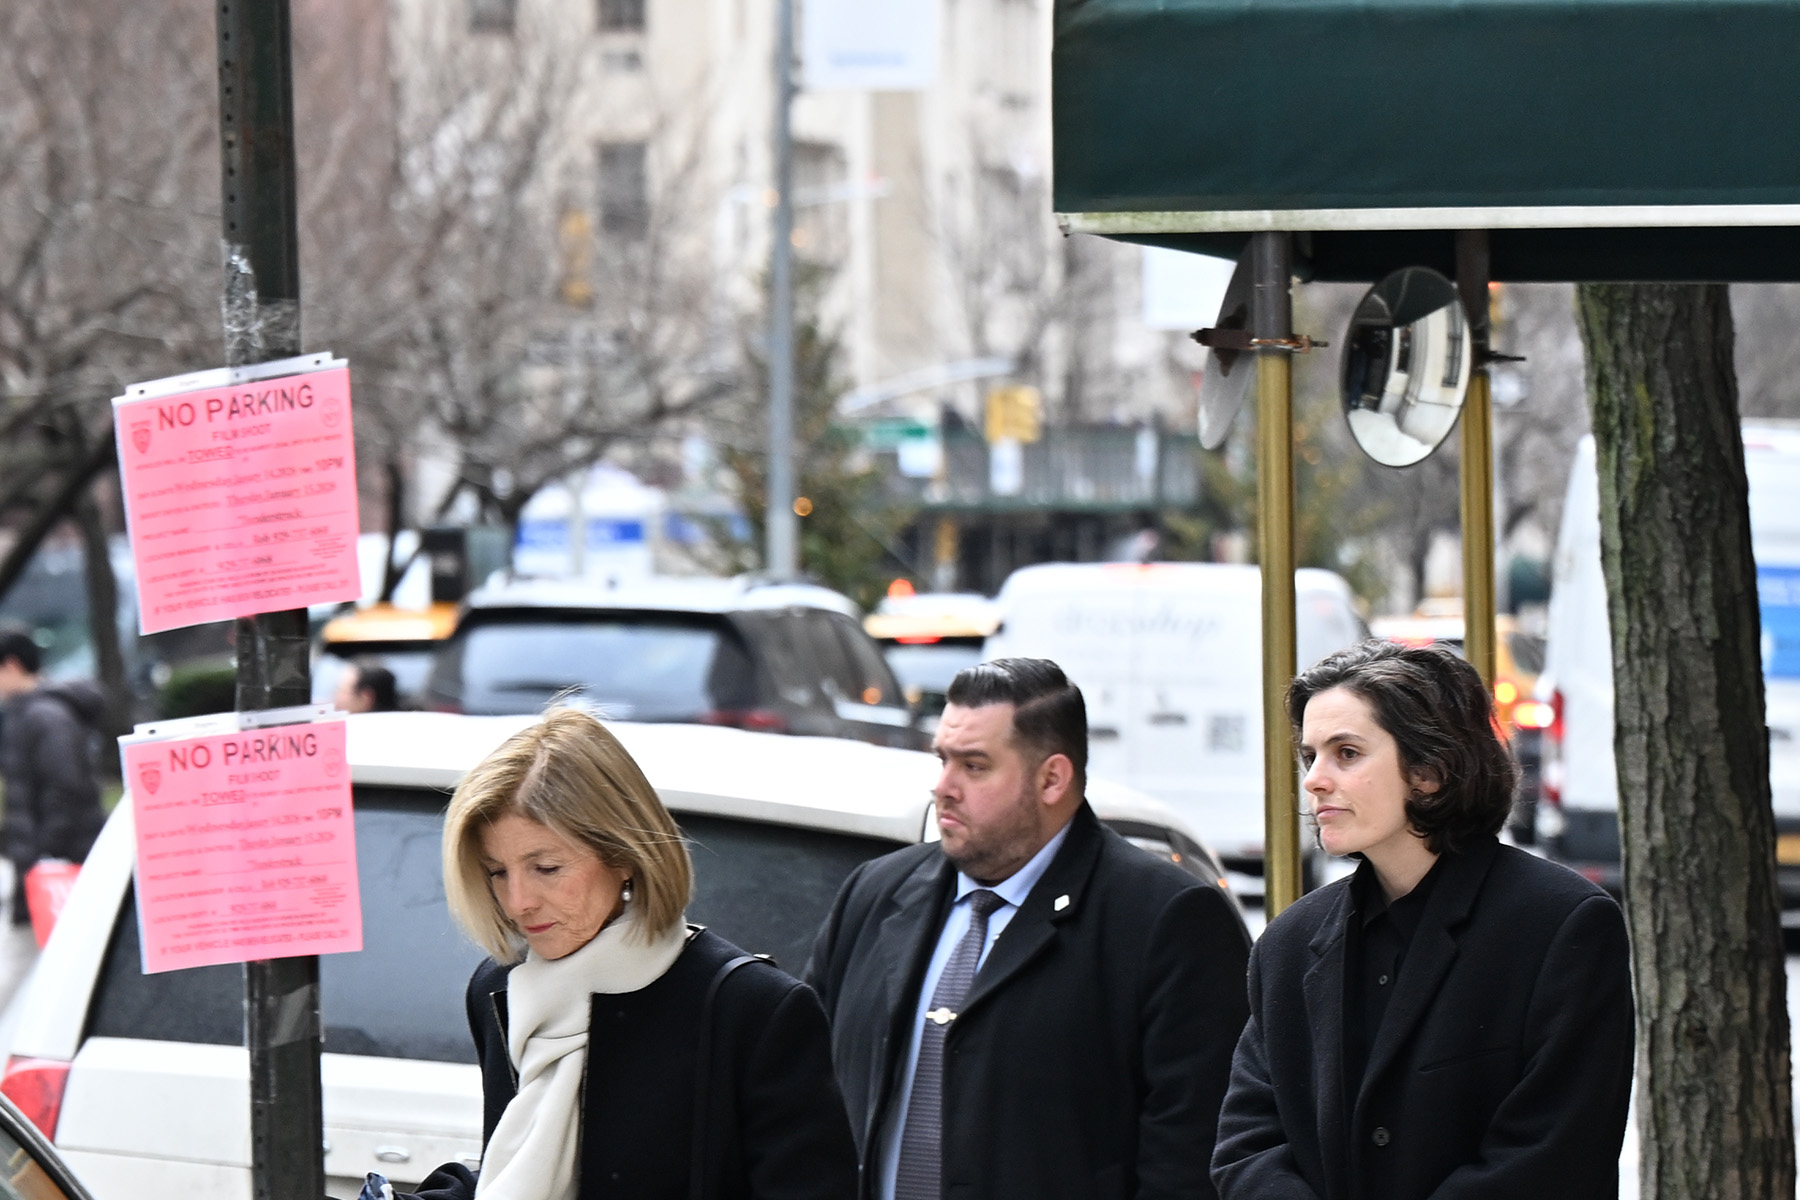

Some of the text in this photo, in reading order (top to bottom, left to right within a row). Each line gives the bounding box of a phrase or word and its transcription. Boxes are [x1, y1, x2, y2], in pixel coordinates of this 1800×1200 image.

[158, 384, 314, 431] NO PARKING
[186, 445, 233, 462] TOWED
[170, 733, 317, 773] NO PARKING
